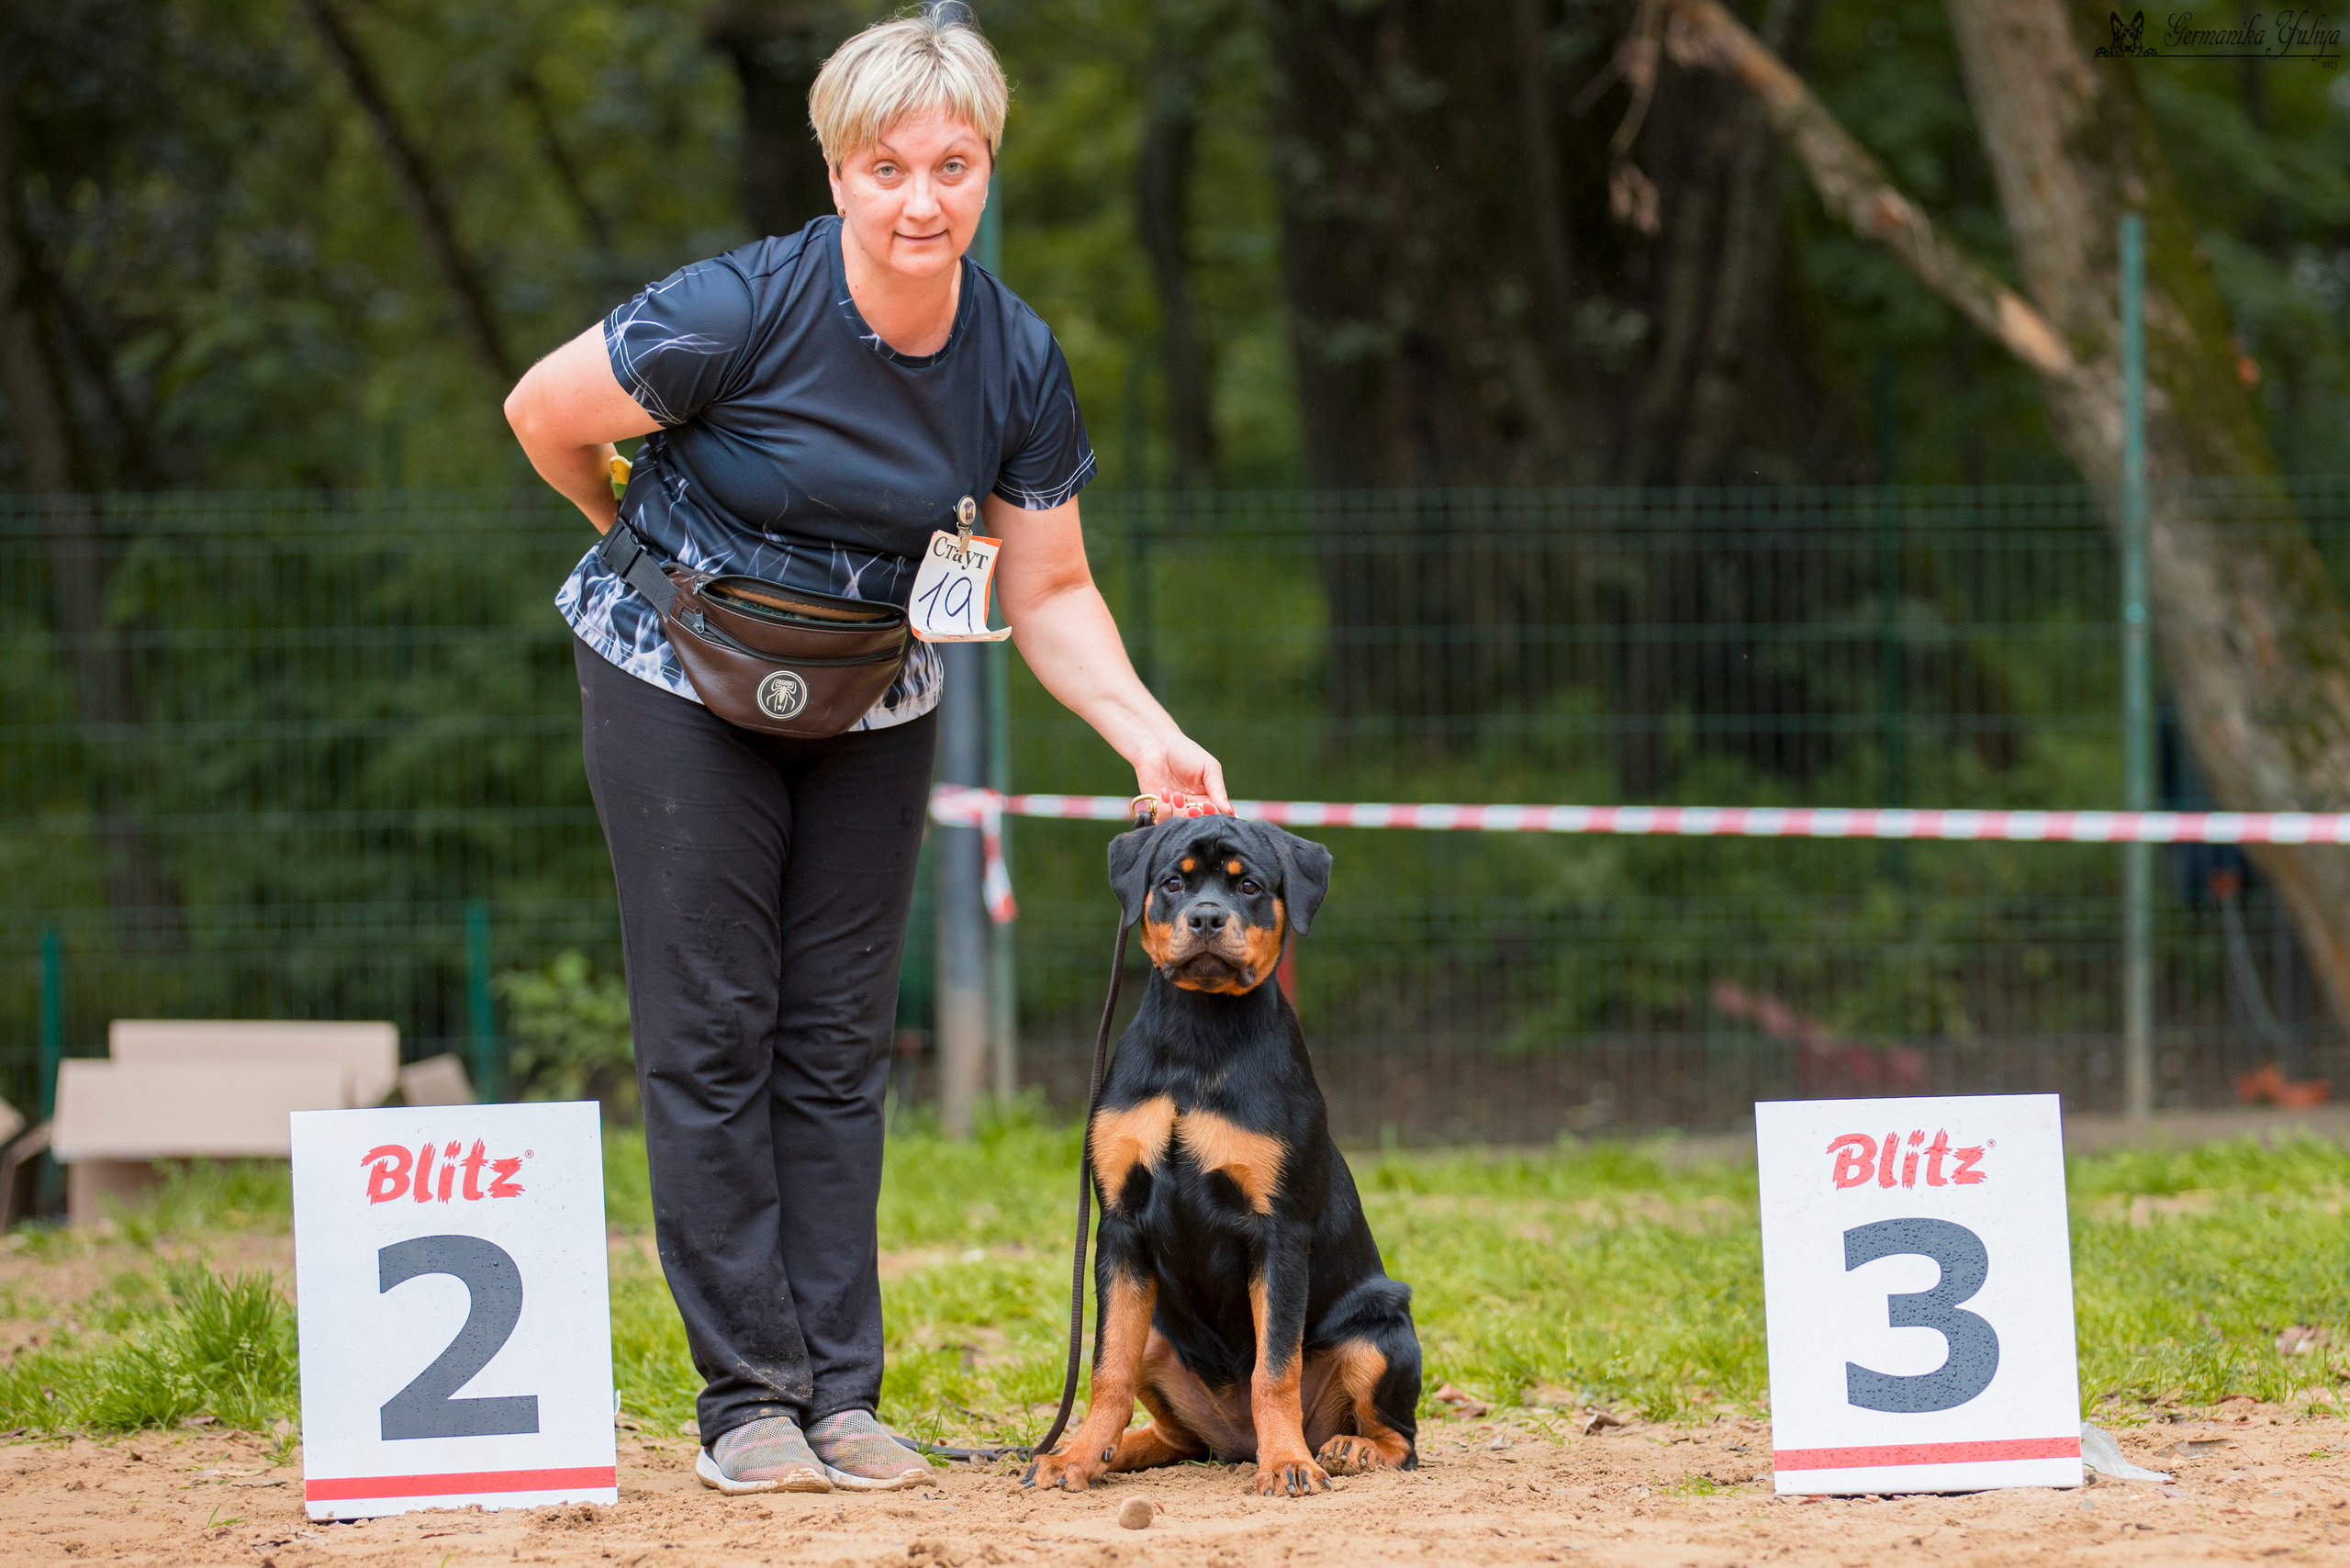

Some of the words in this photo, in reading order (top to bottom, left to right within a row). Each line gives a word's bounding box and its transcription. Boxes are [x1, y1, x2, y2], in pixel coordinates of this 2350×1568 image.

[918, 572, 973, 633] 19
[361, 1137, 526, 1205] Blitz
[1826, 1128, 1988, 1190] Blitz
[378, 1235, 540, 1441] 2
[1842, 1217, 2000, 1414] 3
